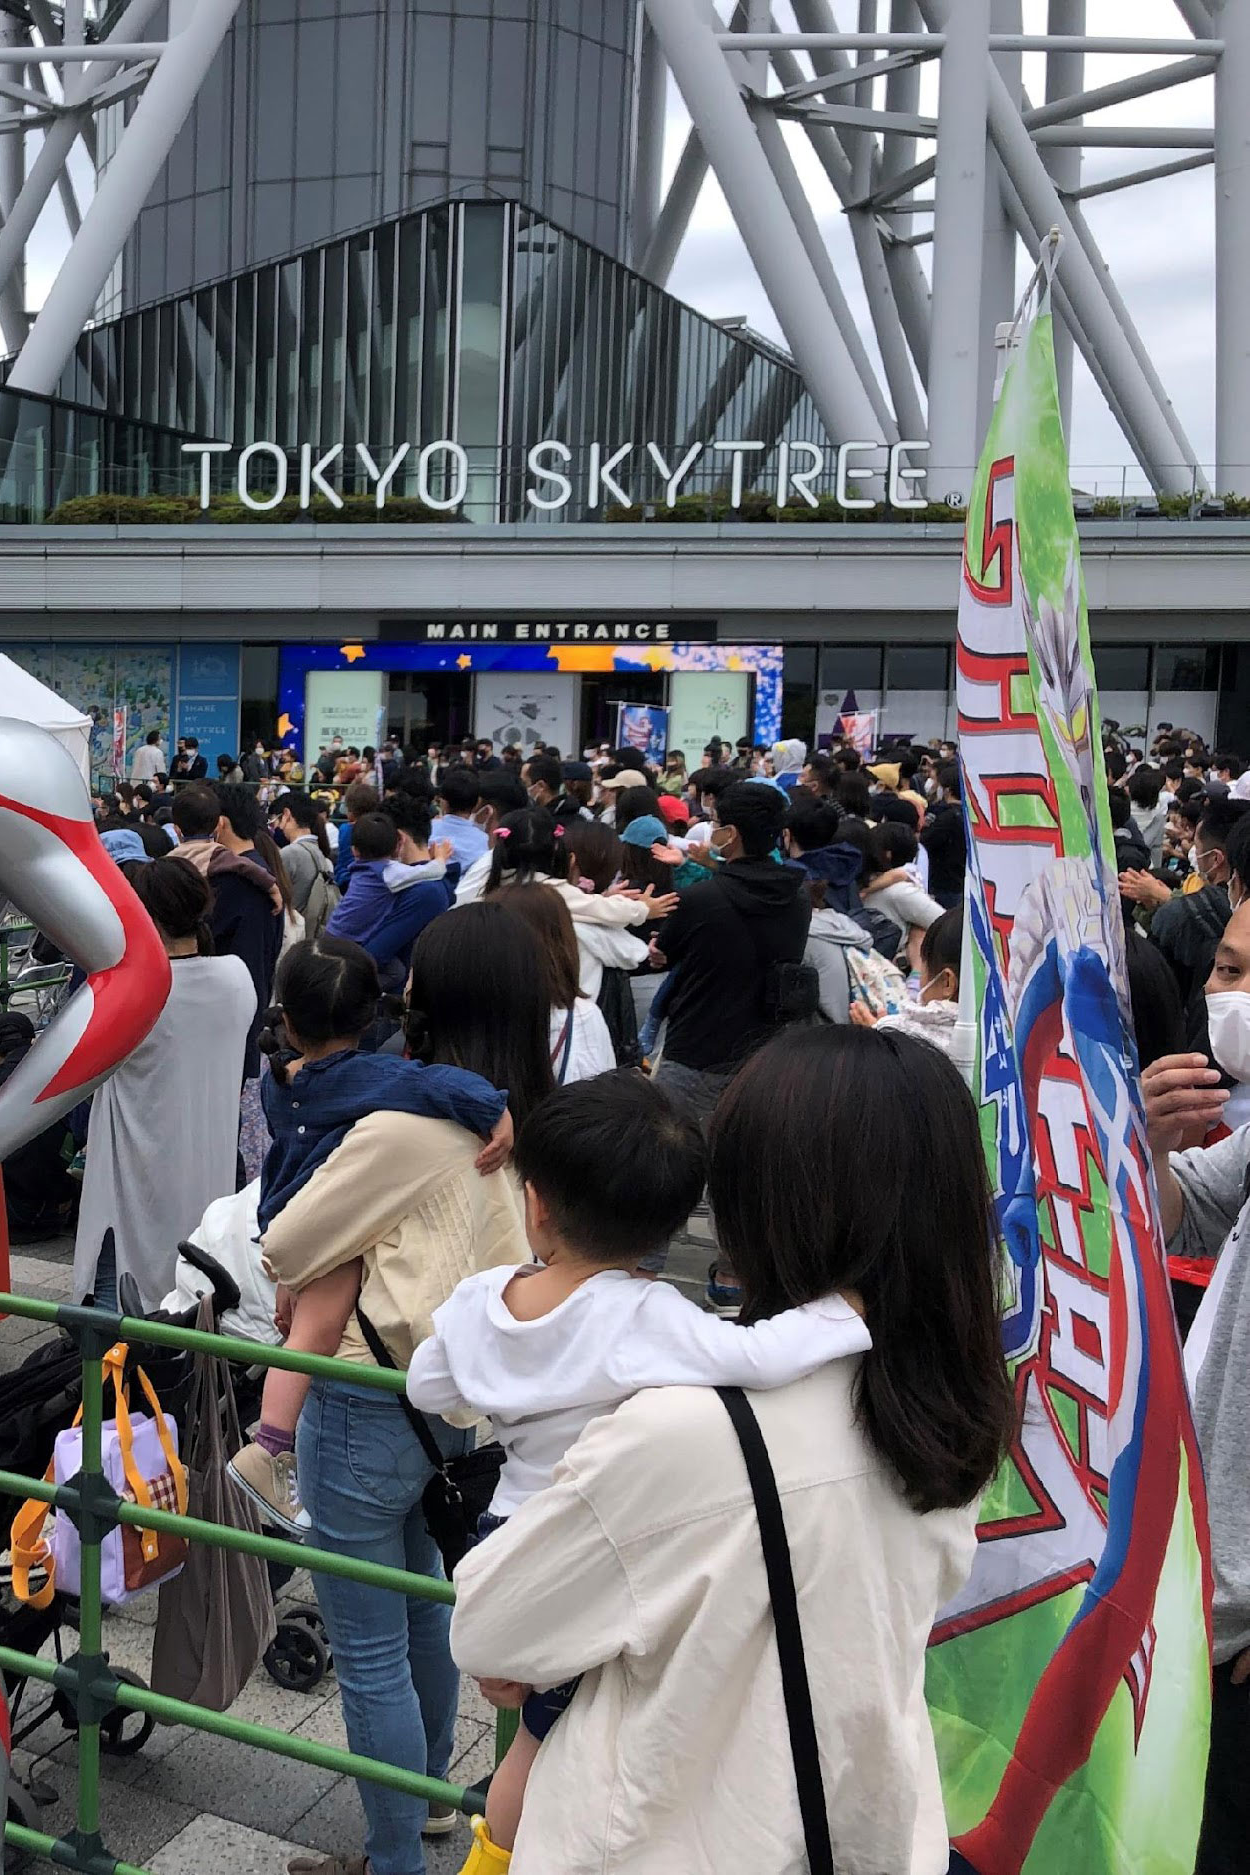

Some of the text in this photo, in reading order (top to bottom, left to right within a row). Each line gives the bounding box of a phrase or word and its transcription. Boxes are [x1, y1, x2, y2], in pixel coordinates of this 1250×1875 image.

[180, 438, 470, 512] TOKYO
[525, 438, 932, 511] SKYTREE
[425, 621, 671, 641] MAIN ENTRANCE
[184, 704, 217, 713] SHARE
[184, 715, 199, 723] MY
[183, 726, 226, 735] SKYTREE
